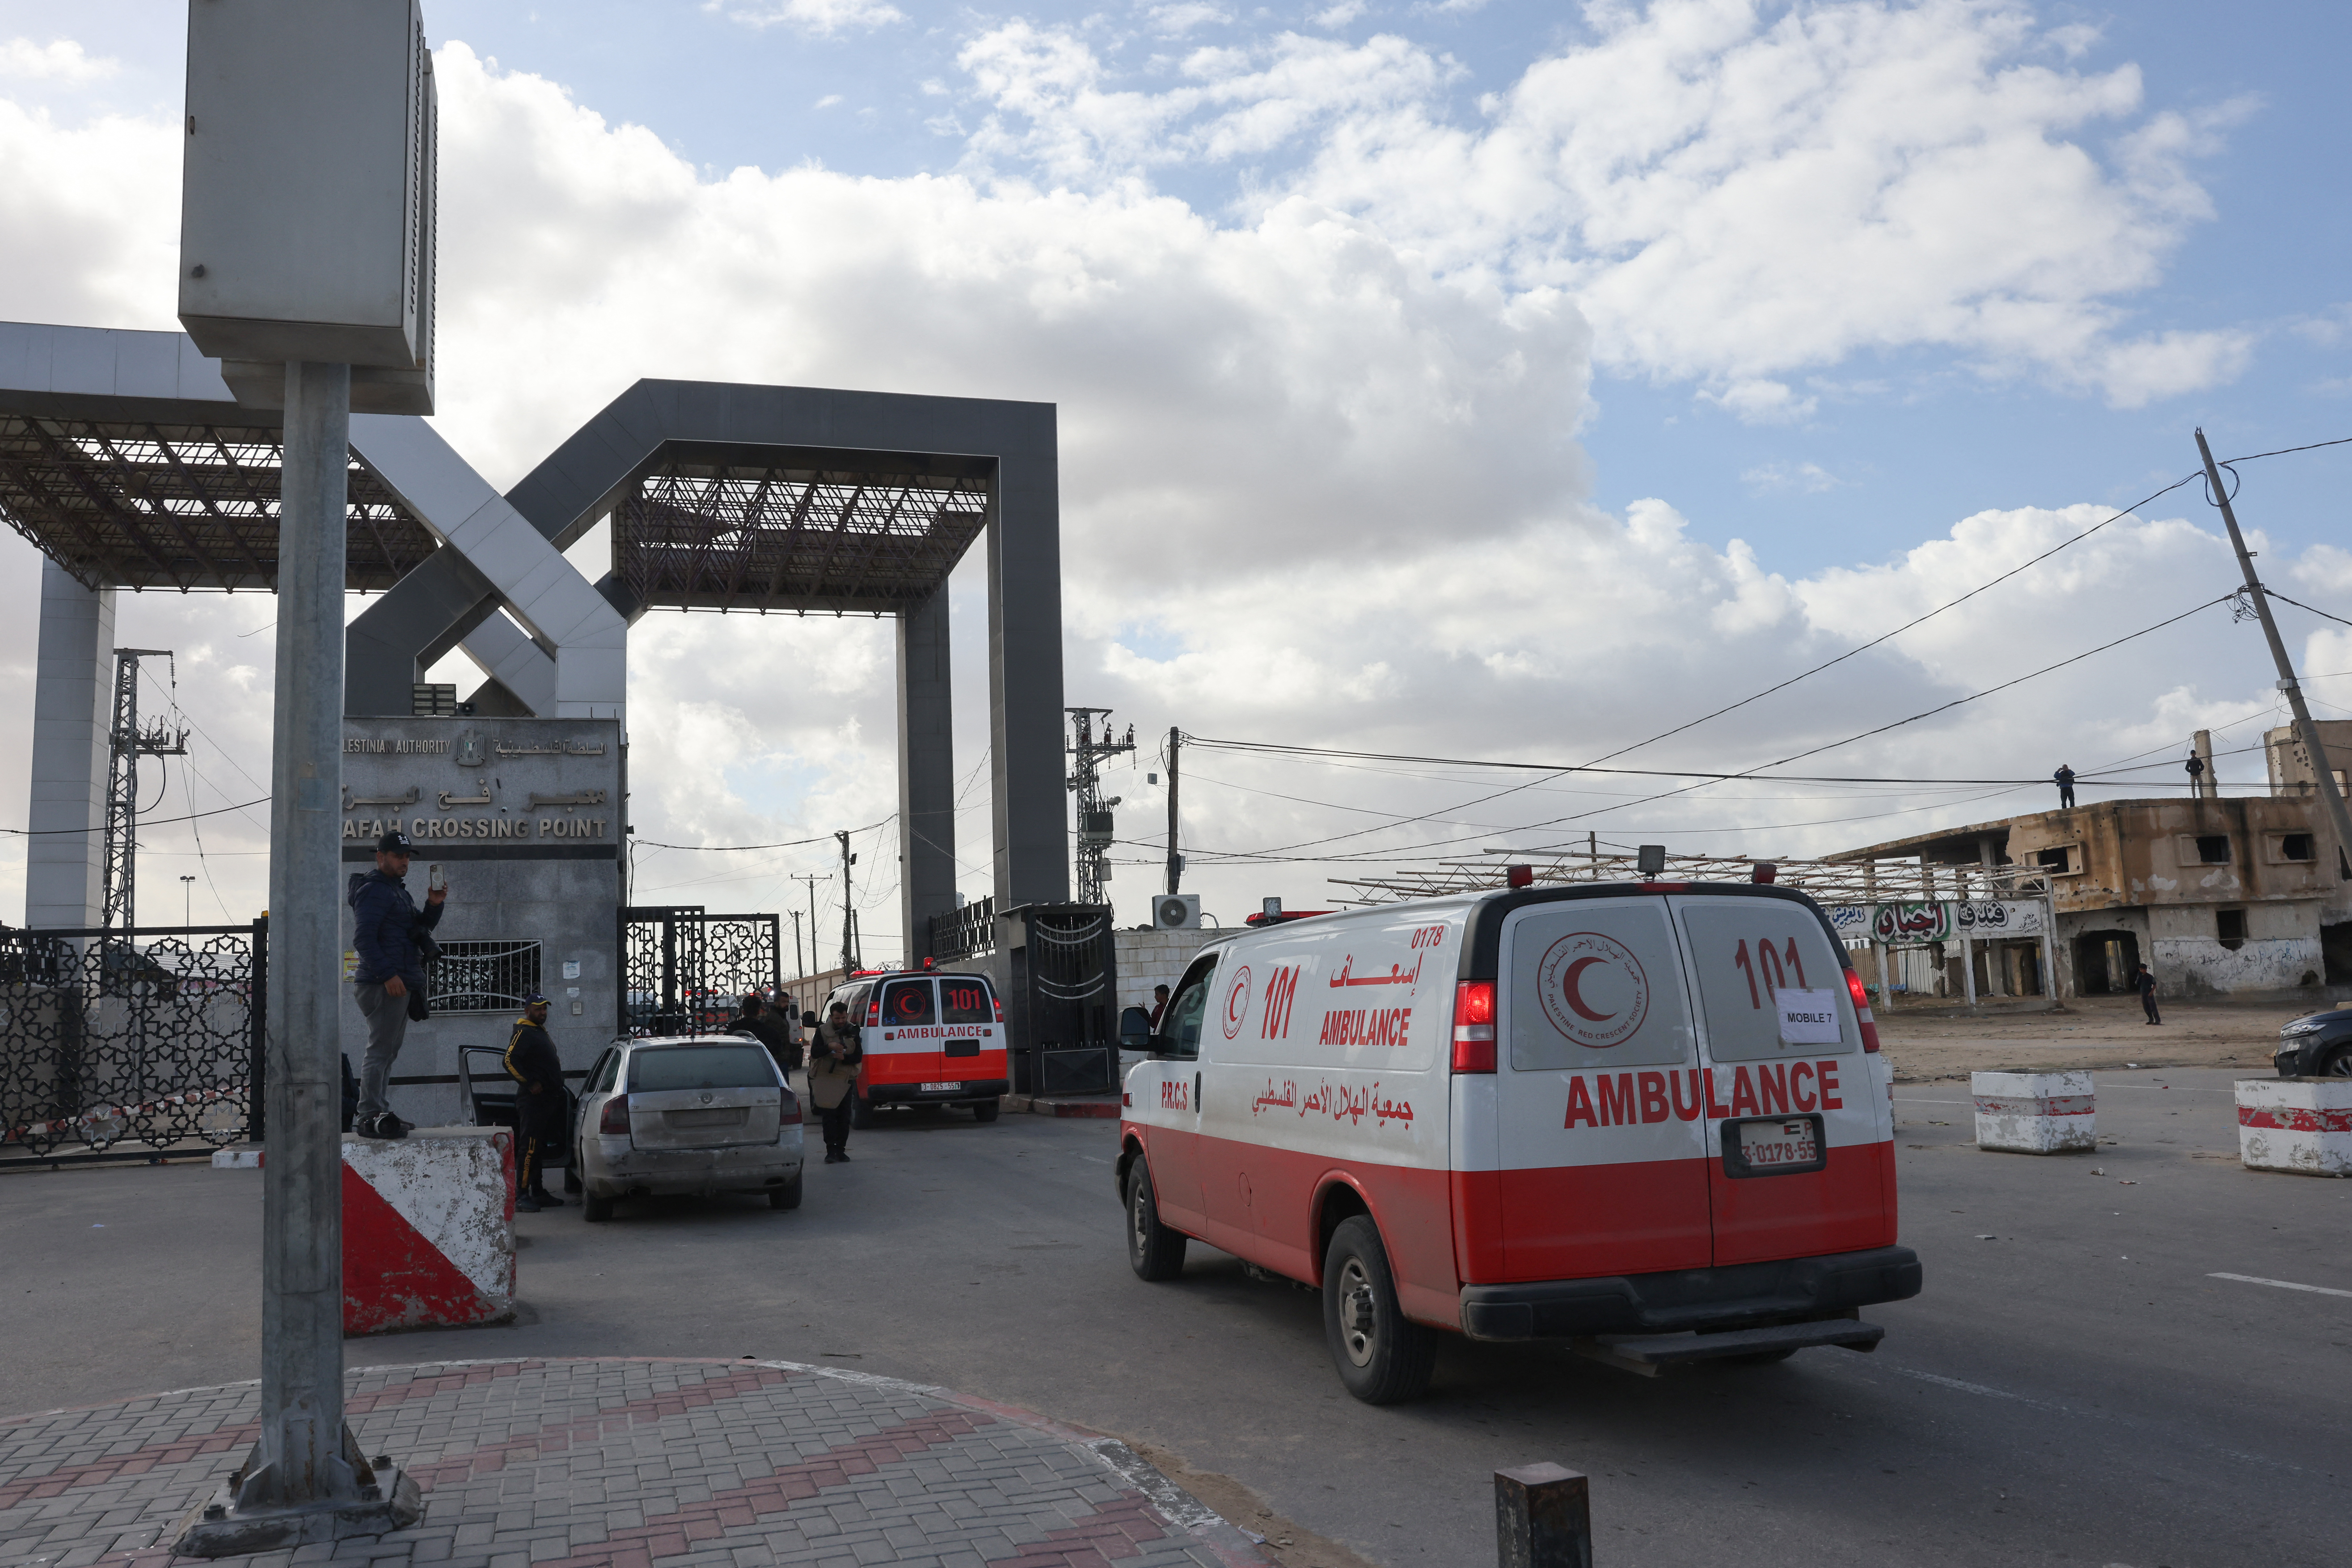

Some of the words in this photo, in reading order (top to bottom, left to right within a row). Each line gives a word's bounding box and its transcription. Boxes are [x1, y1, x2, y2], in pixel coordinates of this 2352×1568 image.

[342, 739, 392, 753] LESTINIAN
[396, 740, 451, 753] AUTHORITY
[493, 739, 566, 758] الفلسطينية
[564, 739, 607, 755] السلطة
[523, 788, 606, 812] معبر
[342, 819, 402, 838] AFAH
[411, 818, 529, 838] CROSSING
[539, 818, 606, 838] POINT
[1878, 901, 1944, 940] أجياد
[1956, 900, 2006, 928] فندق
[1411, 925, 1444, 949] 0178
[1597, 941, 1625, 960] الهلال
[1330, 950, 1423, 997] إسعاف
[1544, 944, 1570, 989] الفلسطيني
[1624, 959, 1640, 985] جمعية
[1735, 937, 1807, 1010] 101
[948, 988, 980, 1010] 101
[1261, 964, 1301, 1040] 101
[883, 1016, 896, 1025] 1-5
[1319, 1008, 1412, 1047] AMBULANCE
[1548, 993, 1575, 1031] PALESTINE
[1578, 1029, 1593, 1039] RED
[1596, 1020, 1630, 1040] CRESCENT
[1629, 990, 1643, 1022] SOCIETY
[1787, 1013, 1825, 1023] MOBILE
[1827, 1013, 1832, 1023] 7
[897, 1026, 982, 1040] AMBULANCE
[1161, 1081, 1188, 1111] P.R.C.S
[1298, 1077, 1332, 1118] الأحمر
[1334, 1083, 1369, 1126] الهلال
[1371, 1081, 1414, 1131] جمعية
[1564, 1060, 1843, 1130] AMBULANCE
[1804, 1122, 1812, 1135] P
